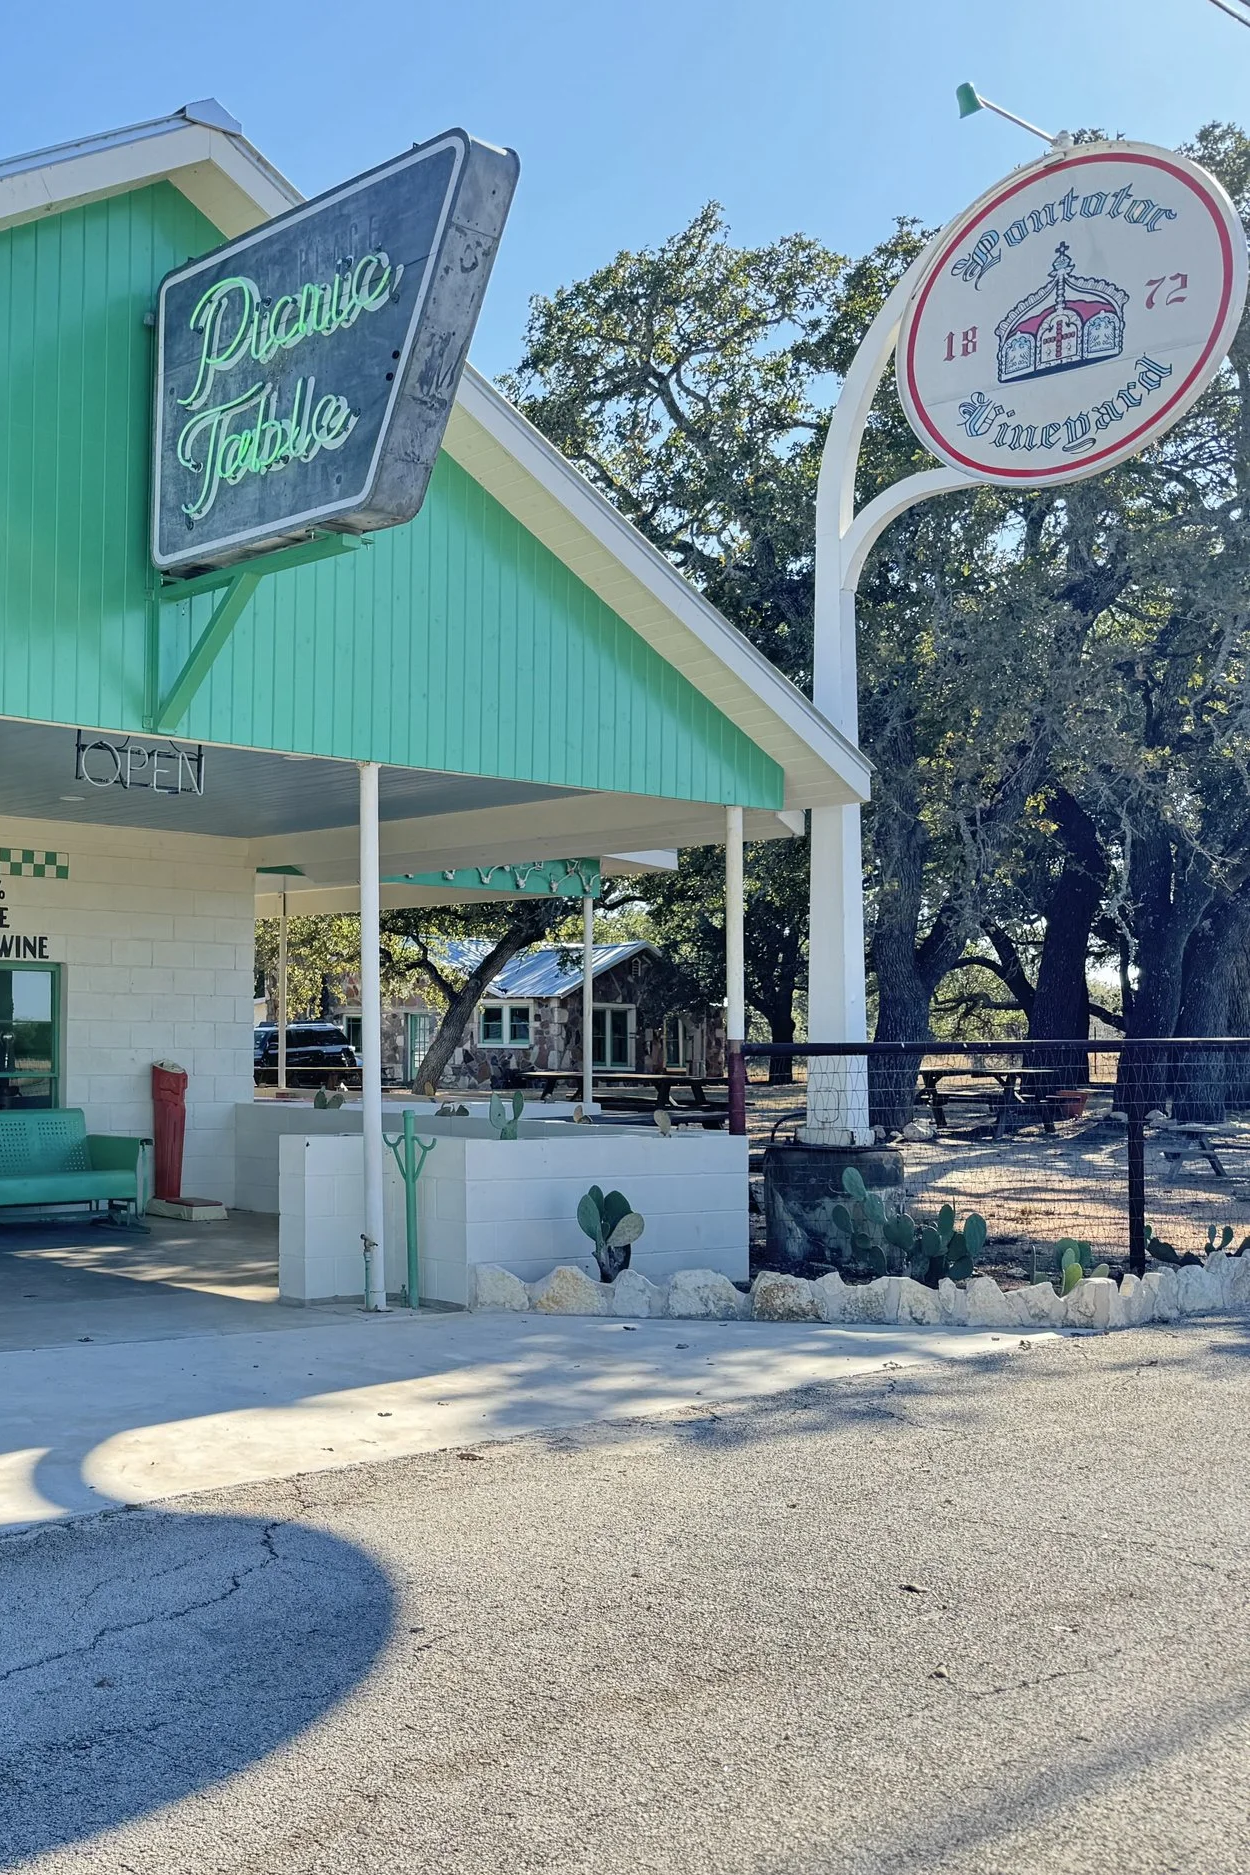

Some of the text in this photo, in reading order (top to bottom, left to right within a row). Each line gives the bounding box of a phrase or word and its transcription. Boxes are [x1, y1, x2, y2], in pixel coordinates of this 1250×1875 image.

[950, 183, 1178, 291] Pontotoc
[177, 252, 404, 412] Picnic
[943, 272, 1189, 362] 18 72
[177, 376, 358, 520] Table
[956, 353, 1173, 454] Vineyard
[81, 740, 205, 796] OPEN
